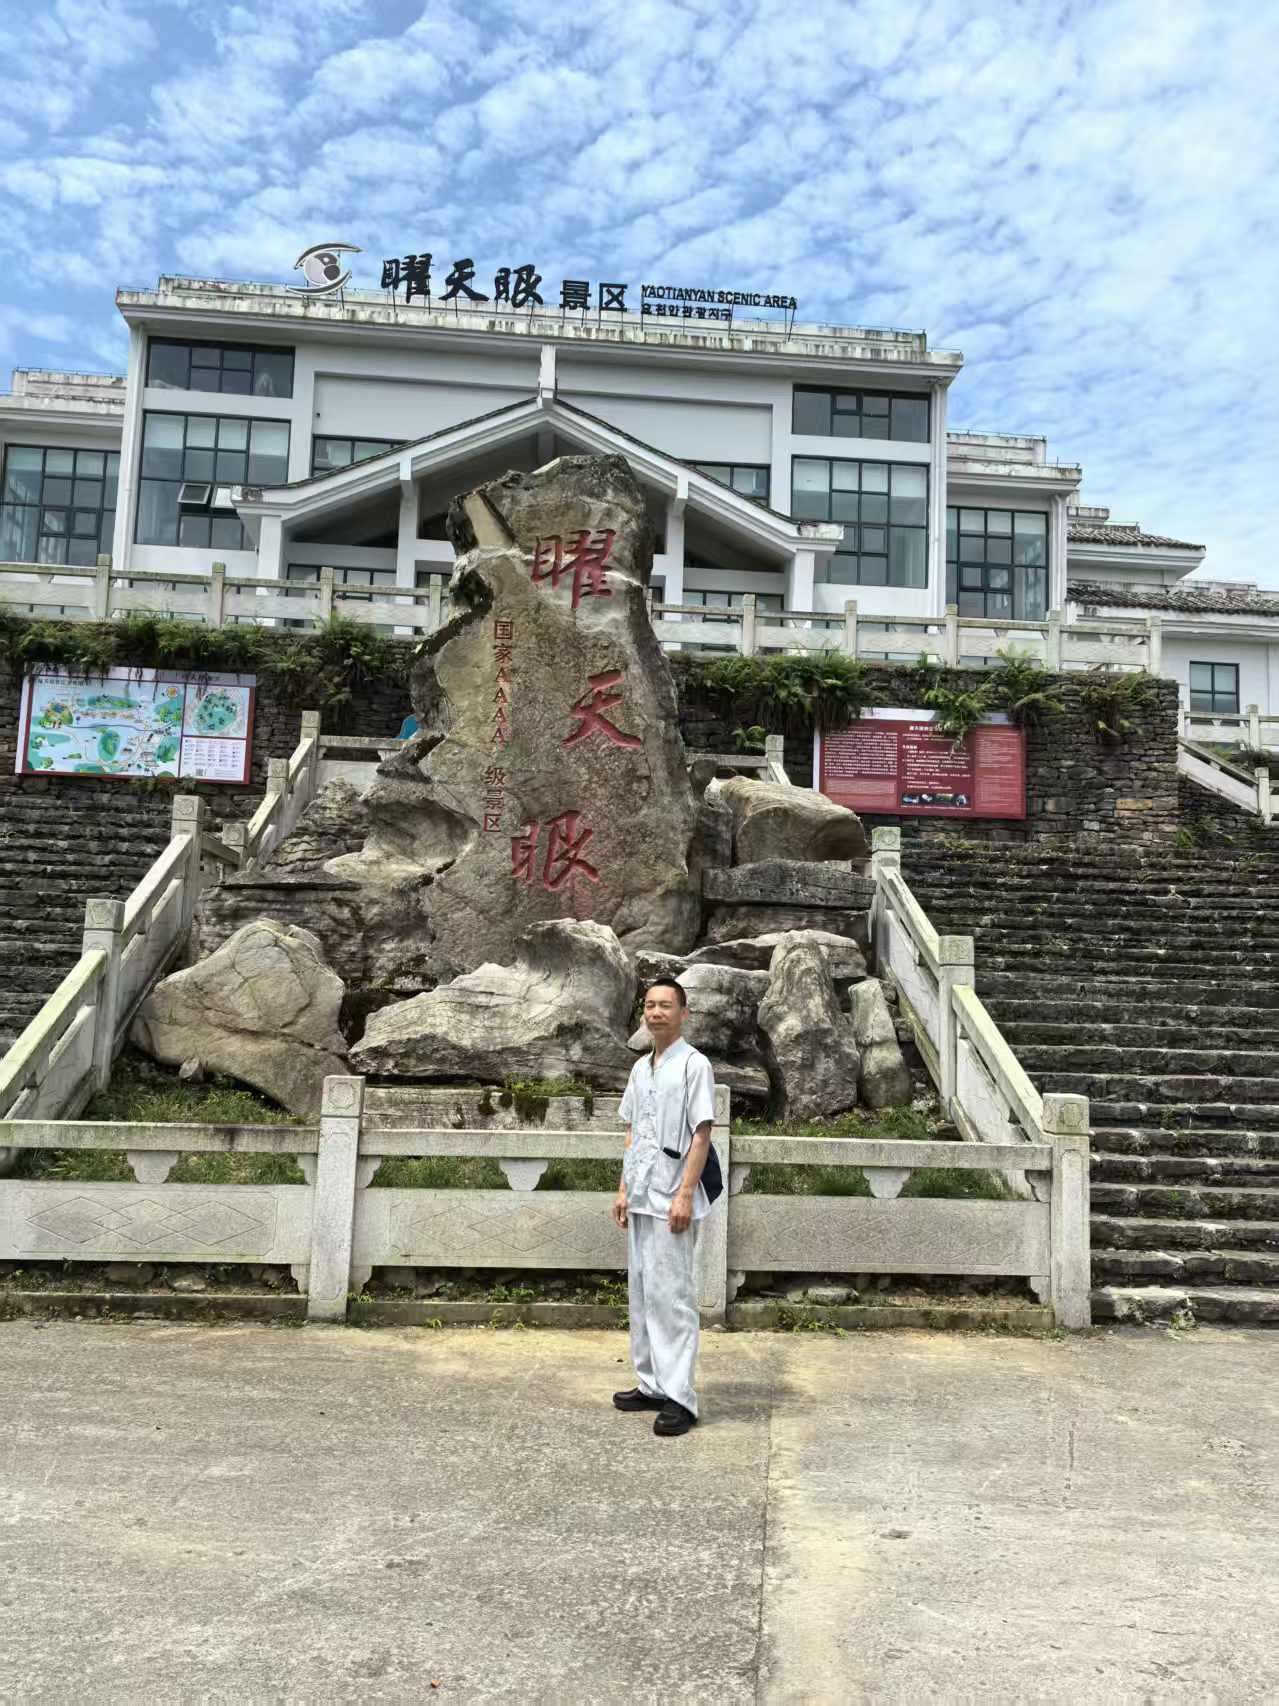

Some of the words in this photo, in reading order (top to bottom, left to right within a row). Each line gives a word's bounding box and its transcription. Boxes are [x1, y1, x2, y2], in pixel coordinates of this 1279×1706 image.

[559, 279, 628, 312] 景区
[641, 284, 716, 303] YAOTIANYAN
[717, 289, 761, 306] SCENIC
[764, 294, 798, 310] AREA
